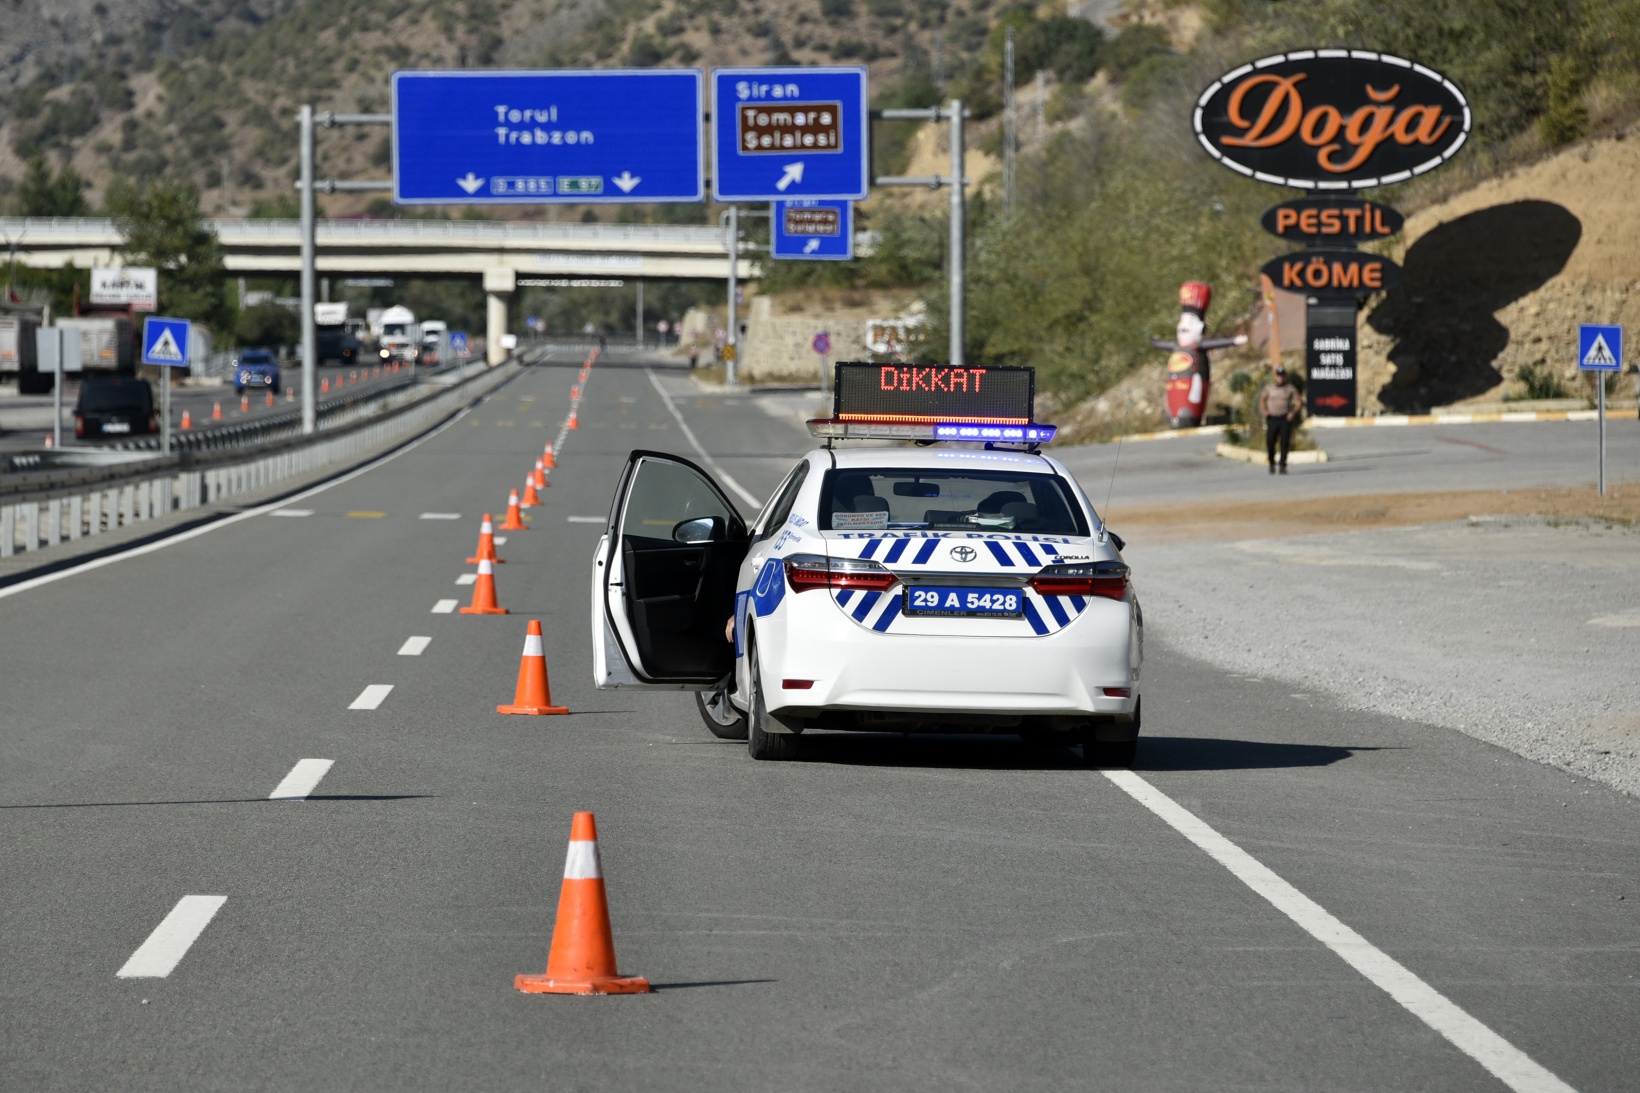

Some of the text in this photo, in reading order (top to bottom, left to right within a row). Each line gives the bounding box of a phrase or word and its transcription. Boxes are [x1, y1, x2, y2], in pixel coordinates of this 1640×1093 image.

[493, 104, 558, 123] Torul
[743, 108, 833, 127] Tomara
[1219, 72, 1453, 173] Doğa
[493, 126, 595, 145] Trabzon
[1276, 202, 1391, 235] PESTİL
[1282, 256, 1383, 288] KÖME
[837, 531, 953, 540] TRAFİK
[913, 590, 1017, 611] 29 A 5428
